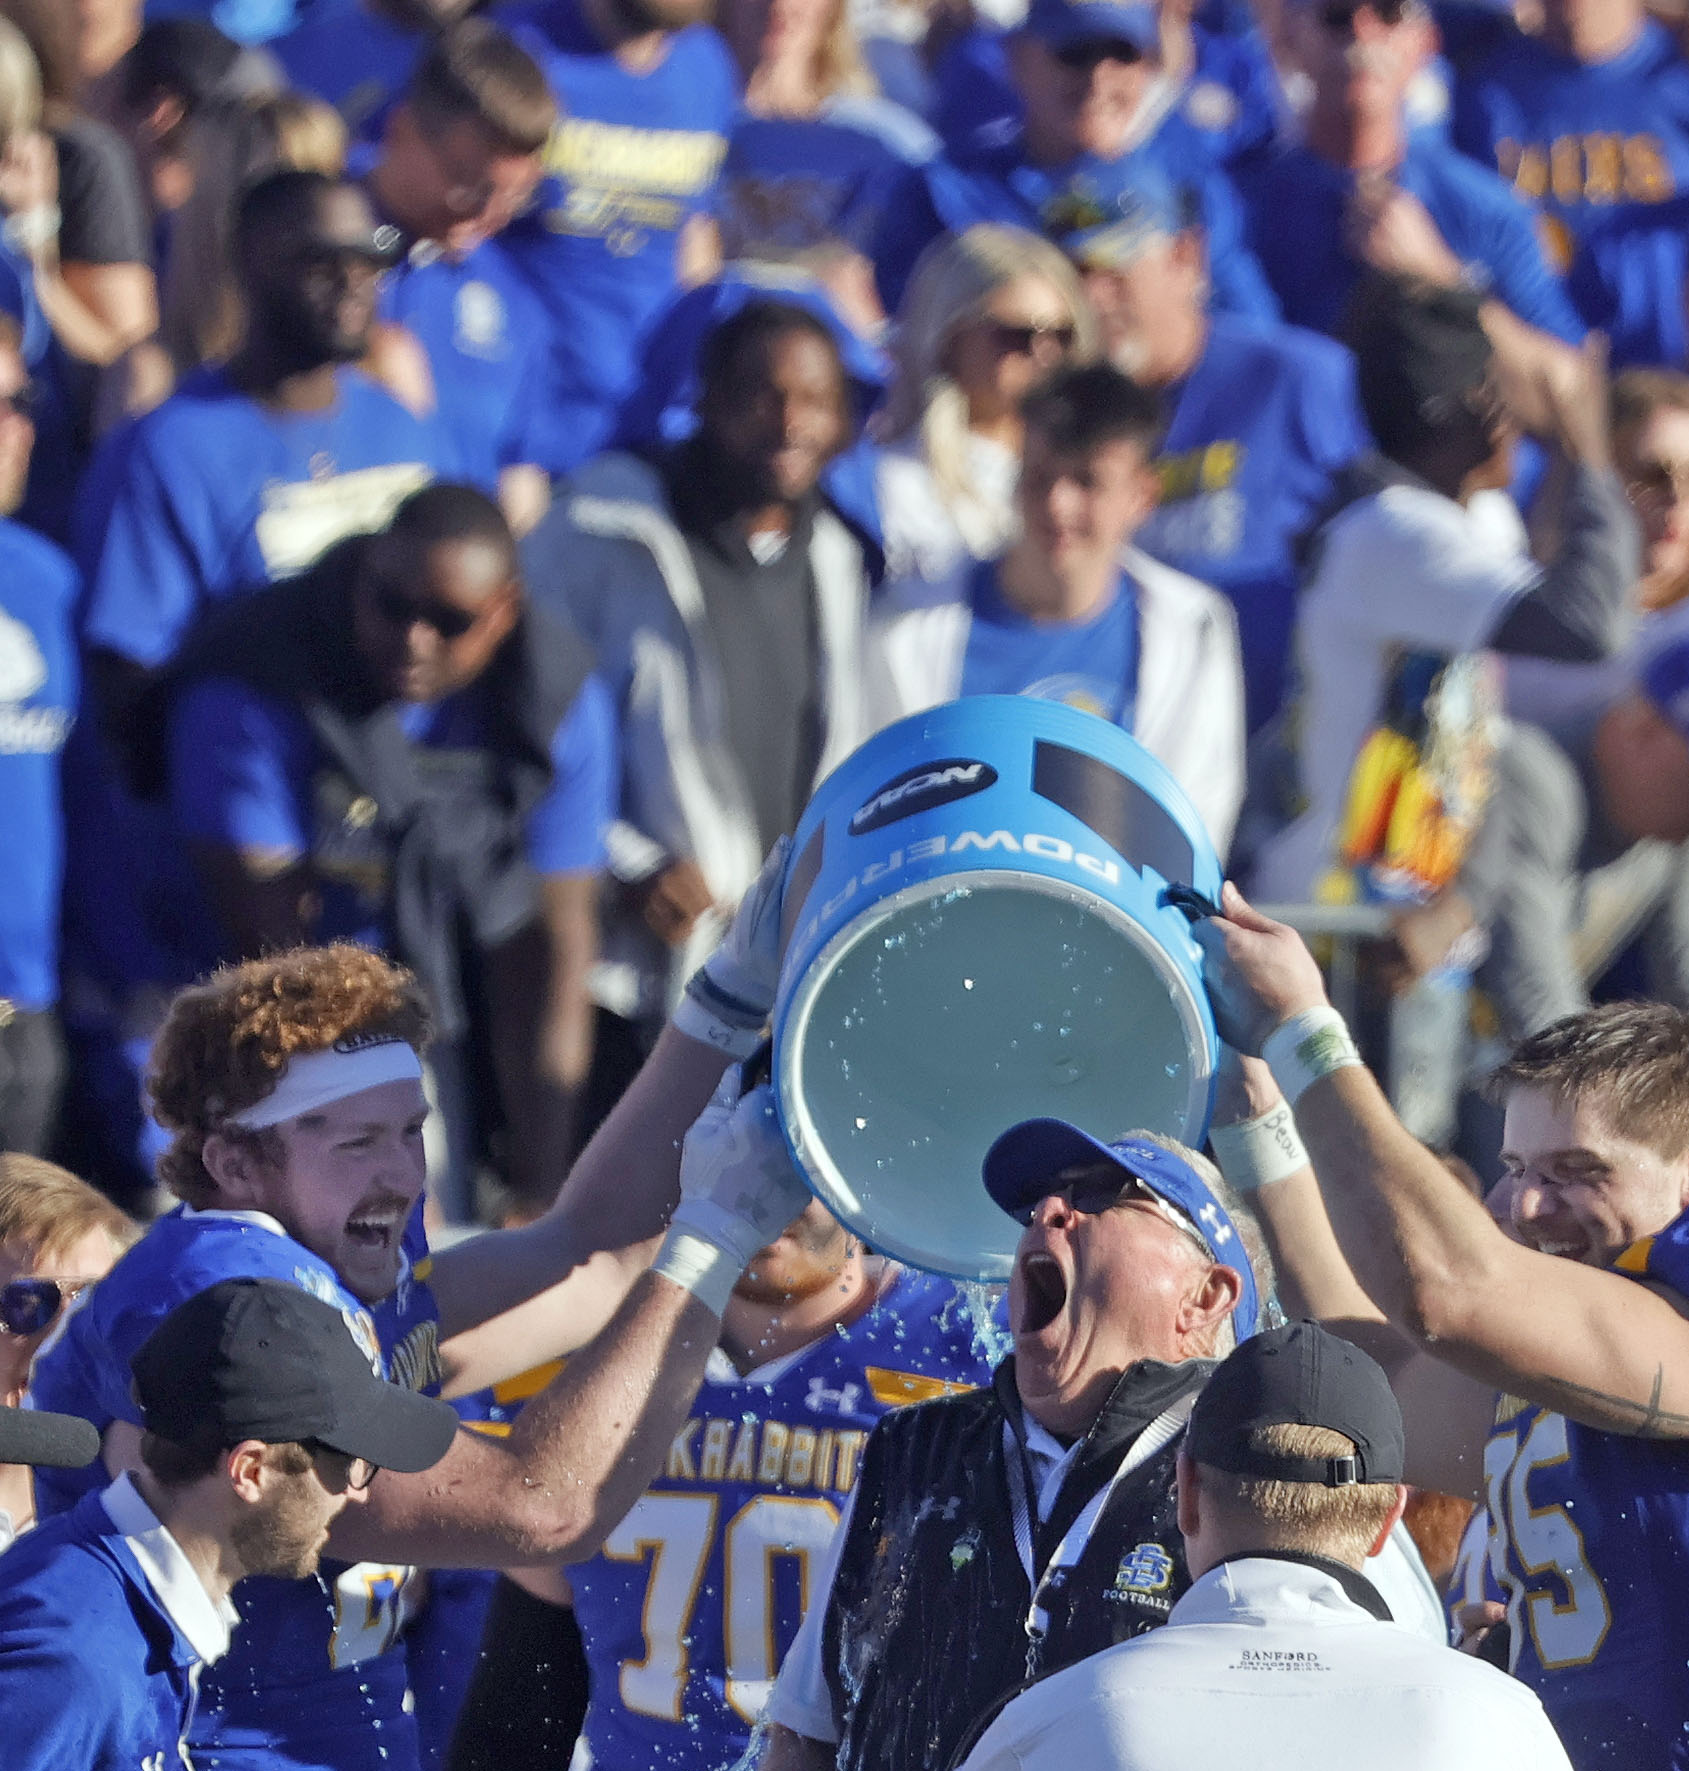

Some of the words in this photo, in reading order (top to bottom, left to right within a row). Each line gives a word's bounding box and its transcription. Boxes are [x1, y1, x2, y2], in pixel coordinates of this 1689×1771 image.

[852, 763, 985, 828] NCAA
[790, 829, 1121, 955] POWERA
[602, 1489, 842, 1728] 70
[1101, 1588, 1170, 1611] FOOTBALL
[1242, 1650, 1318, 1661] SANFORD
